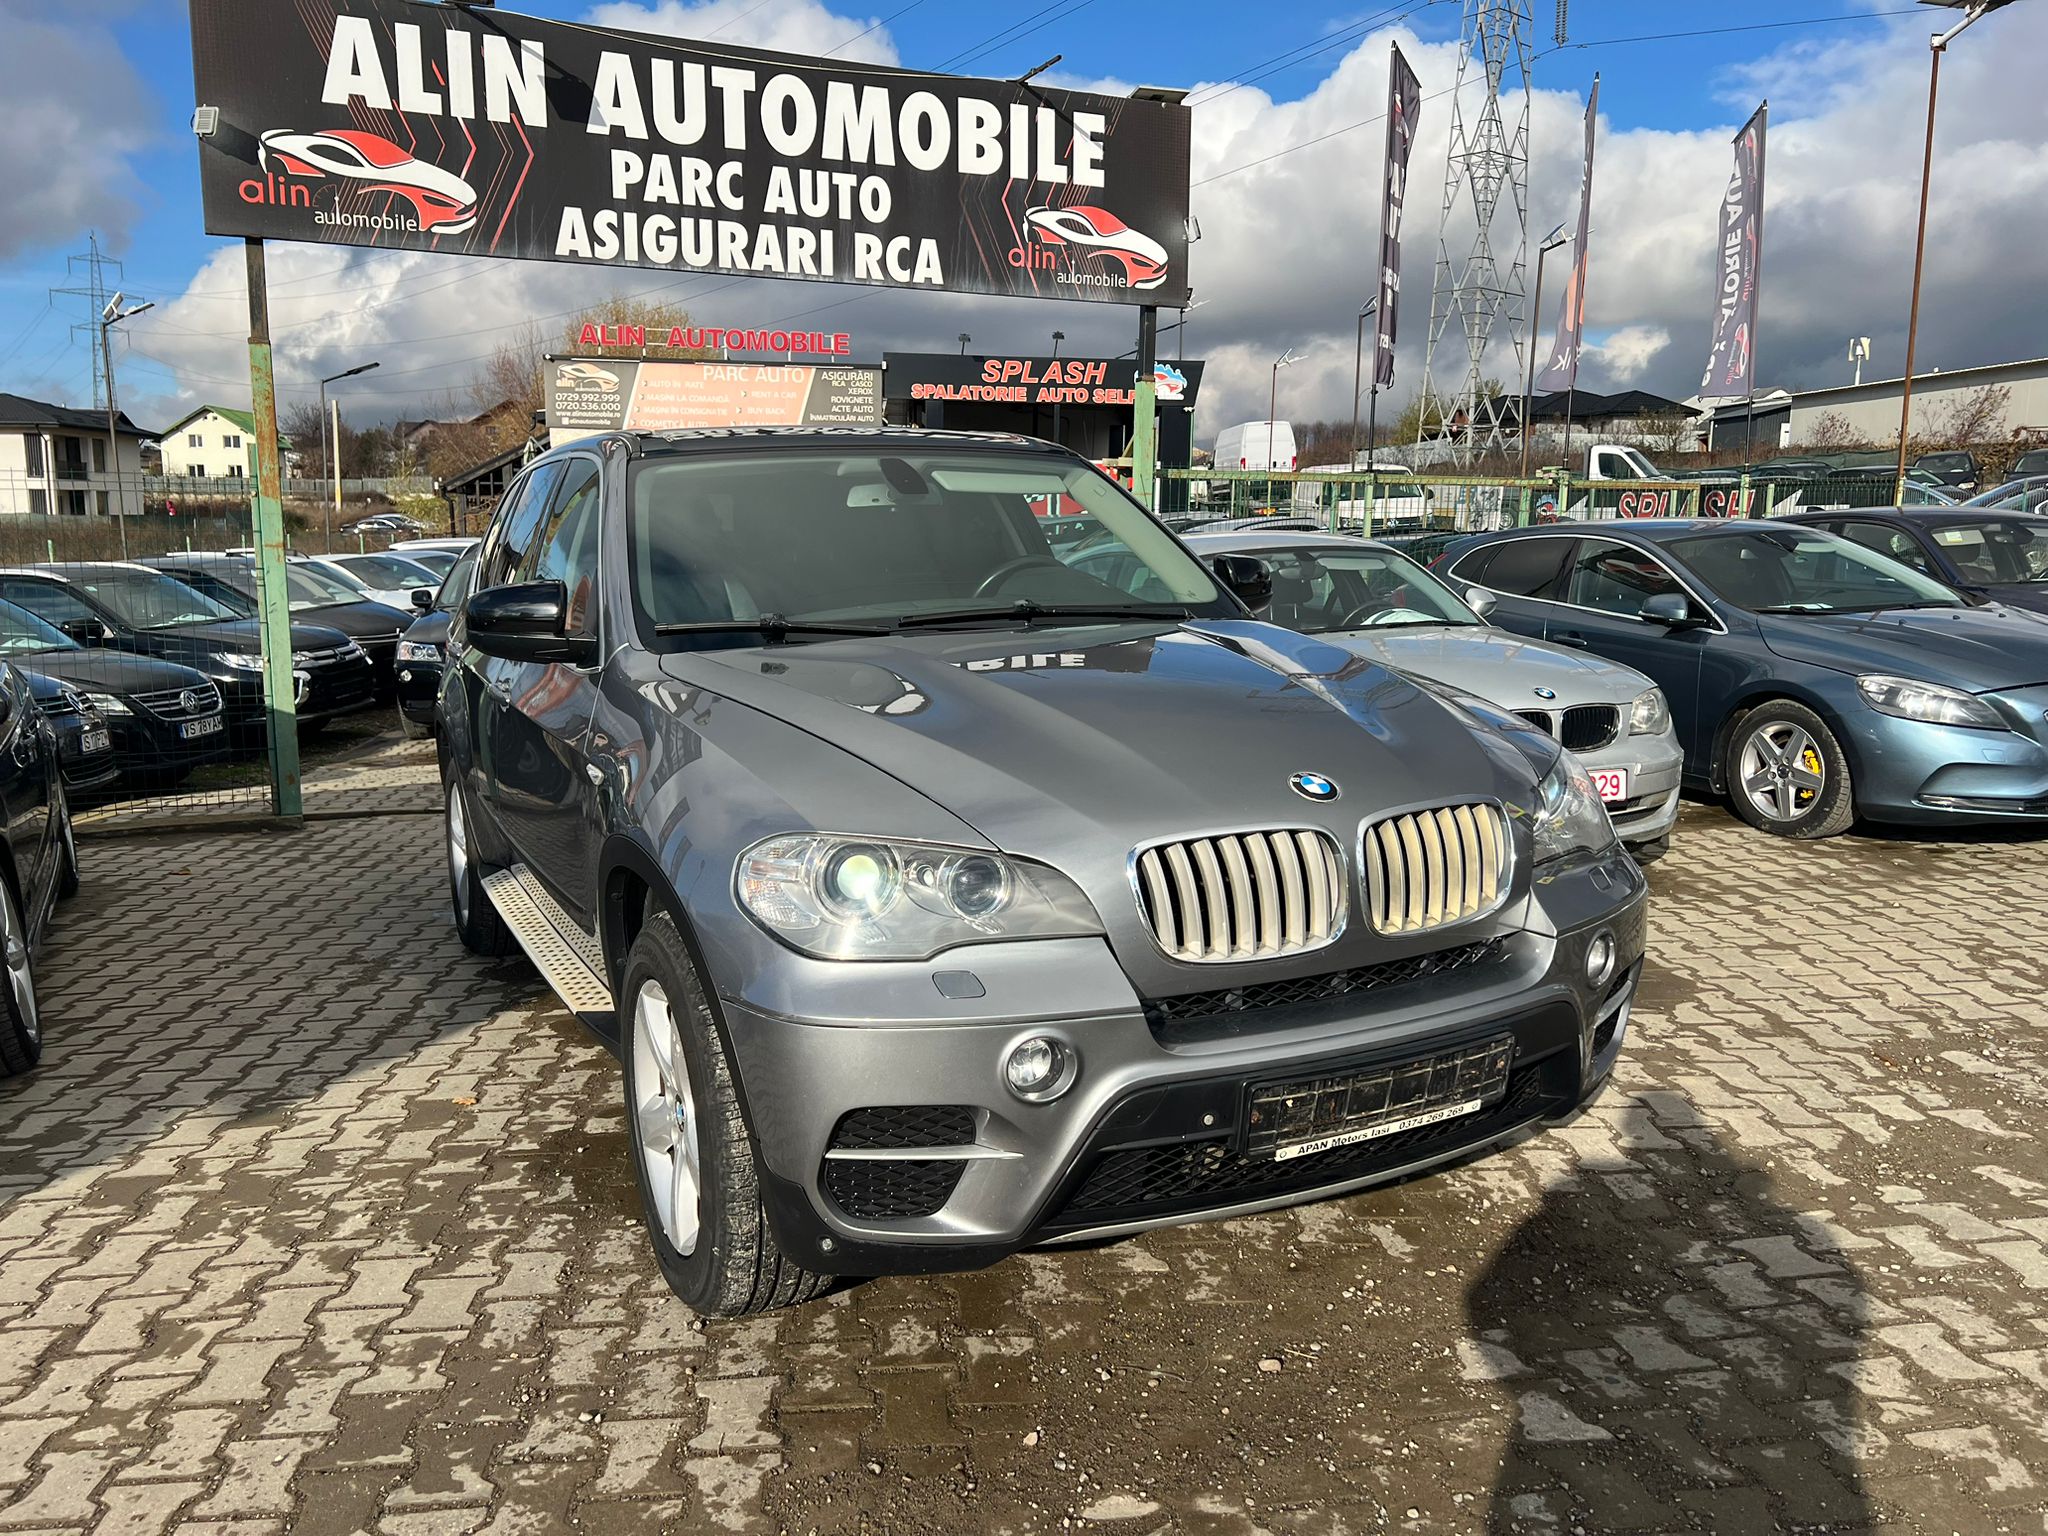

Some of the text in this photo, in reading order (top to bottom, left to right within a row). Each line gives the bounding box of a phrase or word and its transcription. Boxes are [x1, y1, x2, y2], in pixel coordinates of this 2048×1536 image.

[321, 14, 1106, 189] ALIN AUTOMOBILE
[238, 172, 311, 208] alin
[610, 148, 892, 224] PARC AUTO
[313, 197, 418, 232] automobile
[554, 206, 945, 286] ASIGURARI RCA
[1008, 242, 1056, 271] alin
[1057, 261, 1127, 289] automobile
[578, 323, 851, 355] ALIN AUTOMOBILE
[703, 365, 805, 384] PARC AUTO
[850, 380, 873, 388] CASCO
[981, 359, 1108, 385] SPLASH
[555, 393, 621, 402] 0729.992.999
[830, 396, 874, 404] ROVIGNETE
[847, 387, 874, 395] XEROX
[911, 383, 1027, 402] SPALATORIE
[1036, 385, 1089, 404] AUTO
[555, 402, 621, 411] 0720.536.000
[831, 405, 851, 413] ACTE
[1589, 774, 1620, 797] 29
[1297, 1106, 1464, 1155] APAN Motors Iasi 0374 269 269
